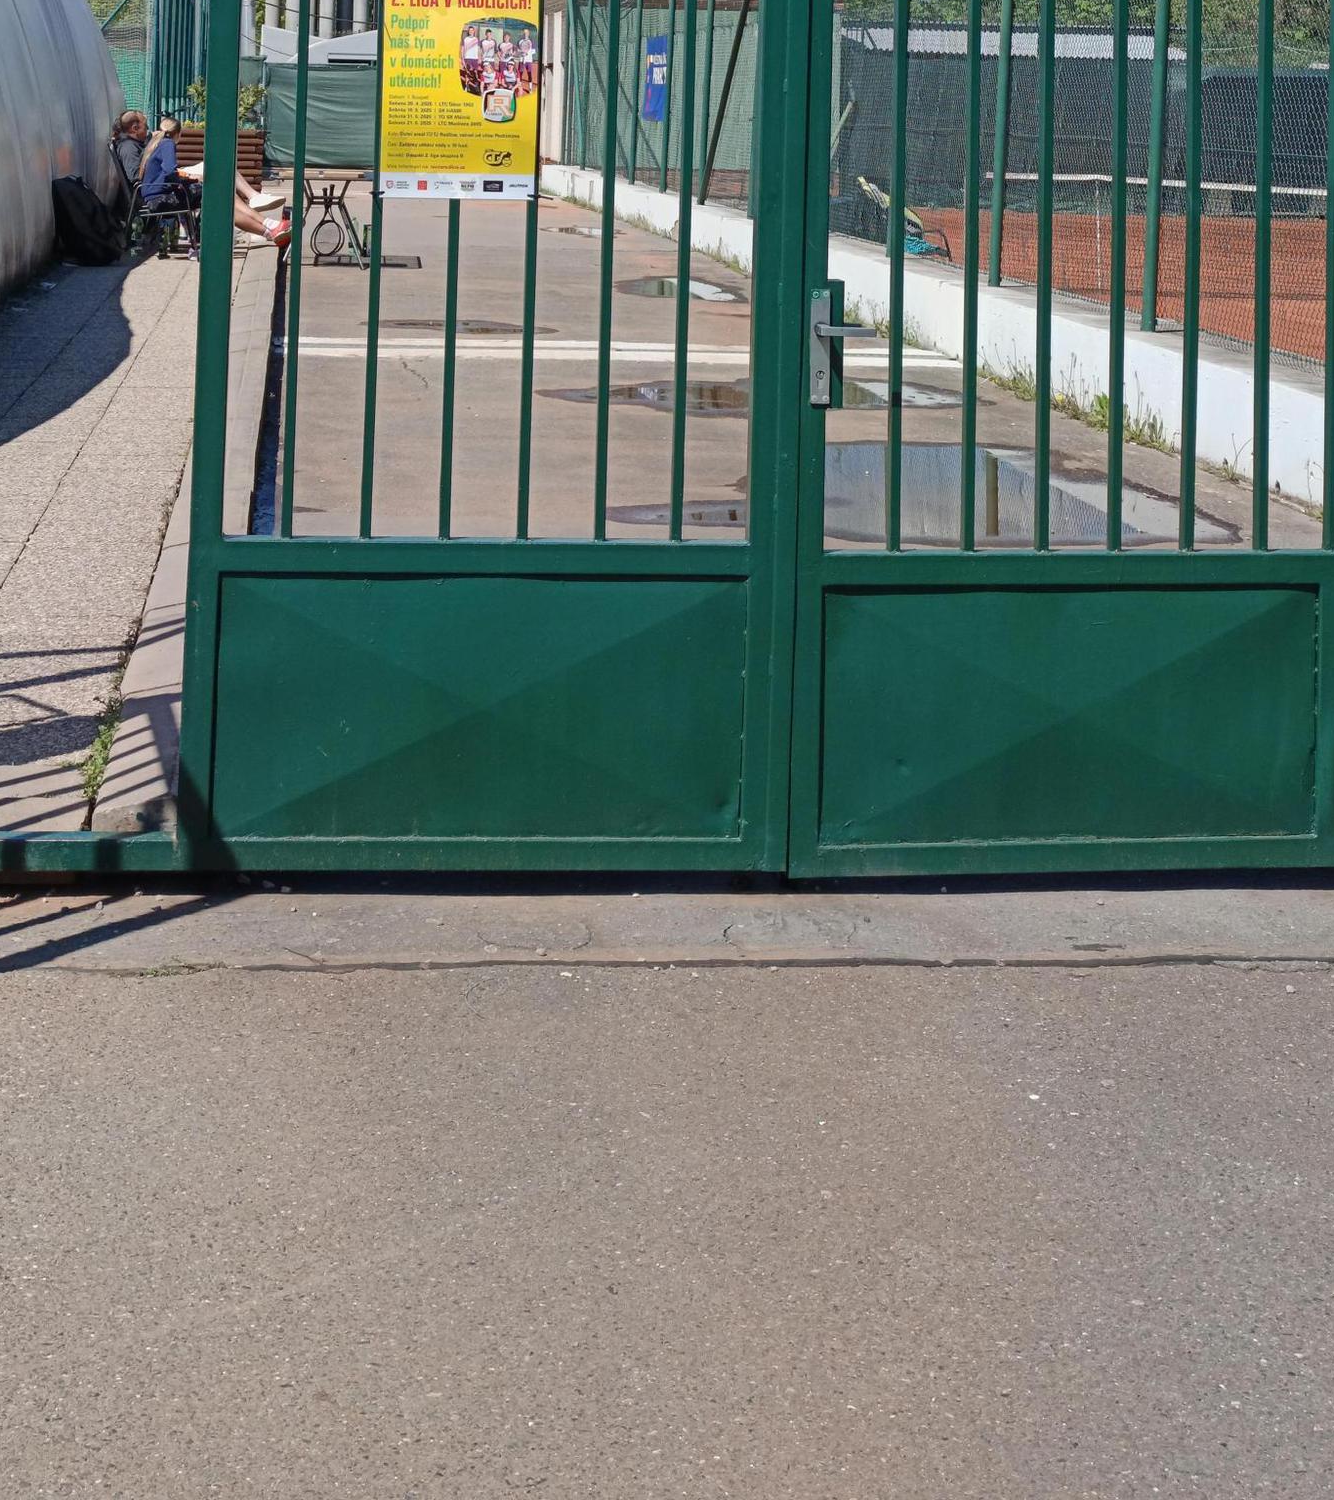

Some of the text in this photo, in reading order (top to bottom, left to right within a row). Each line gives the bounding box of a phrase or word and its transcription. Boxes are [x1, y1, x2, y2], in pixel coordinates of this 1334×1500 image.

[390, 14, 430, 33] Podpoř
[389, 34, 435, 52] náš tým
[389, 54, 454, 70] v domácích
[389, 73, 442, 89] utkáních!
